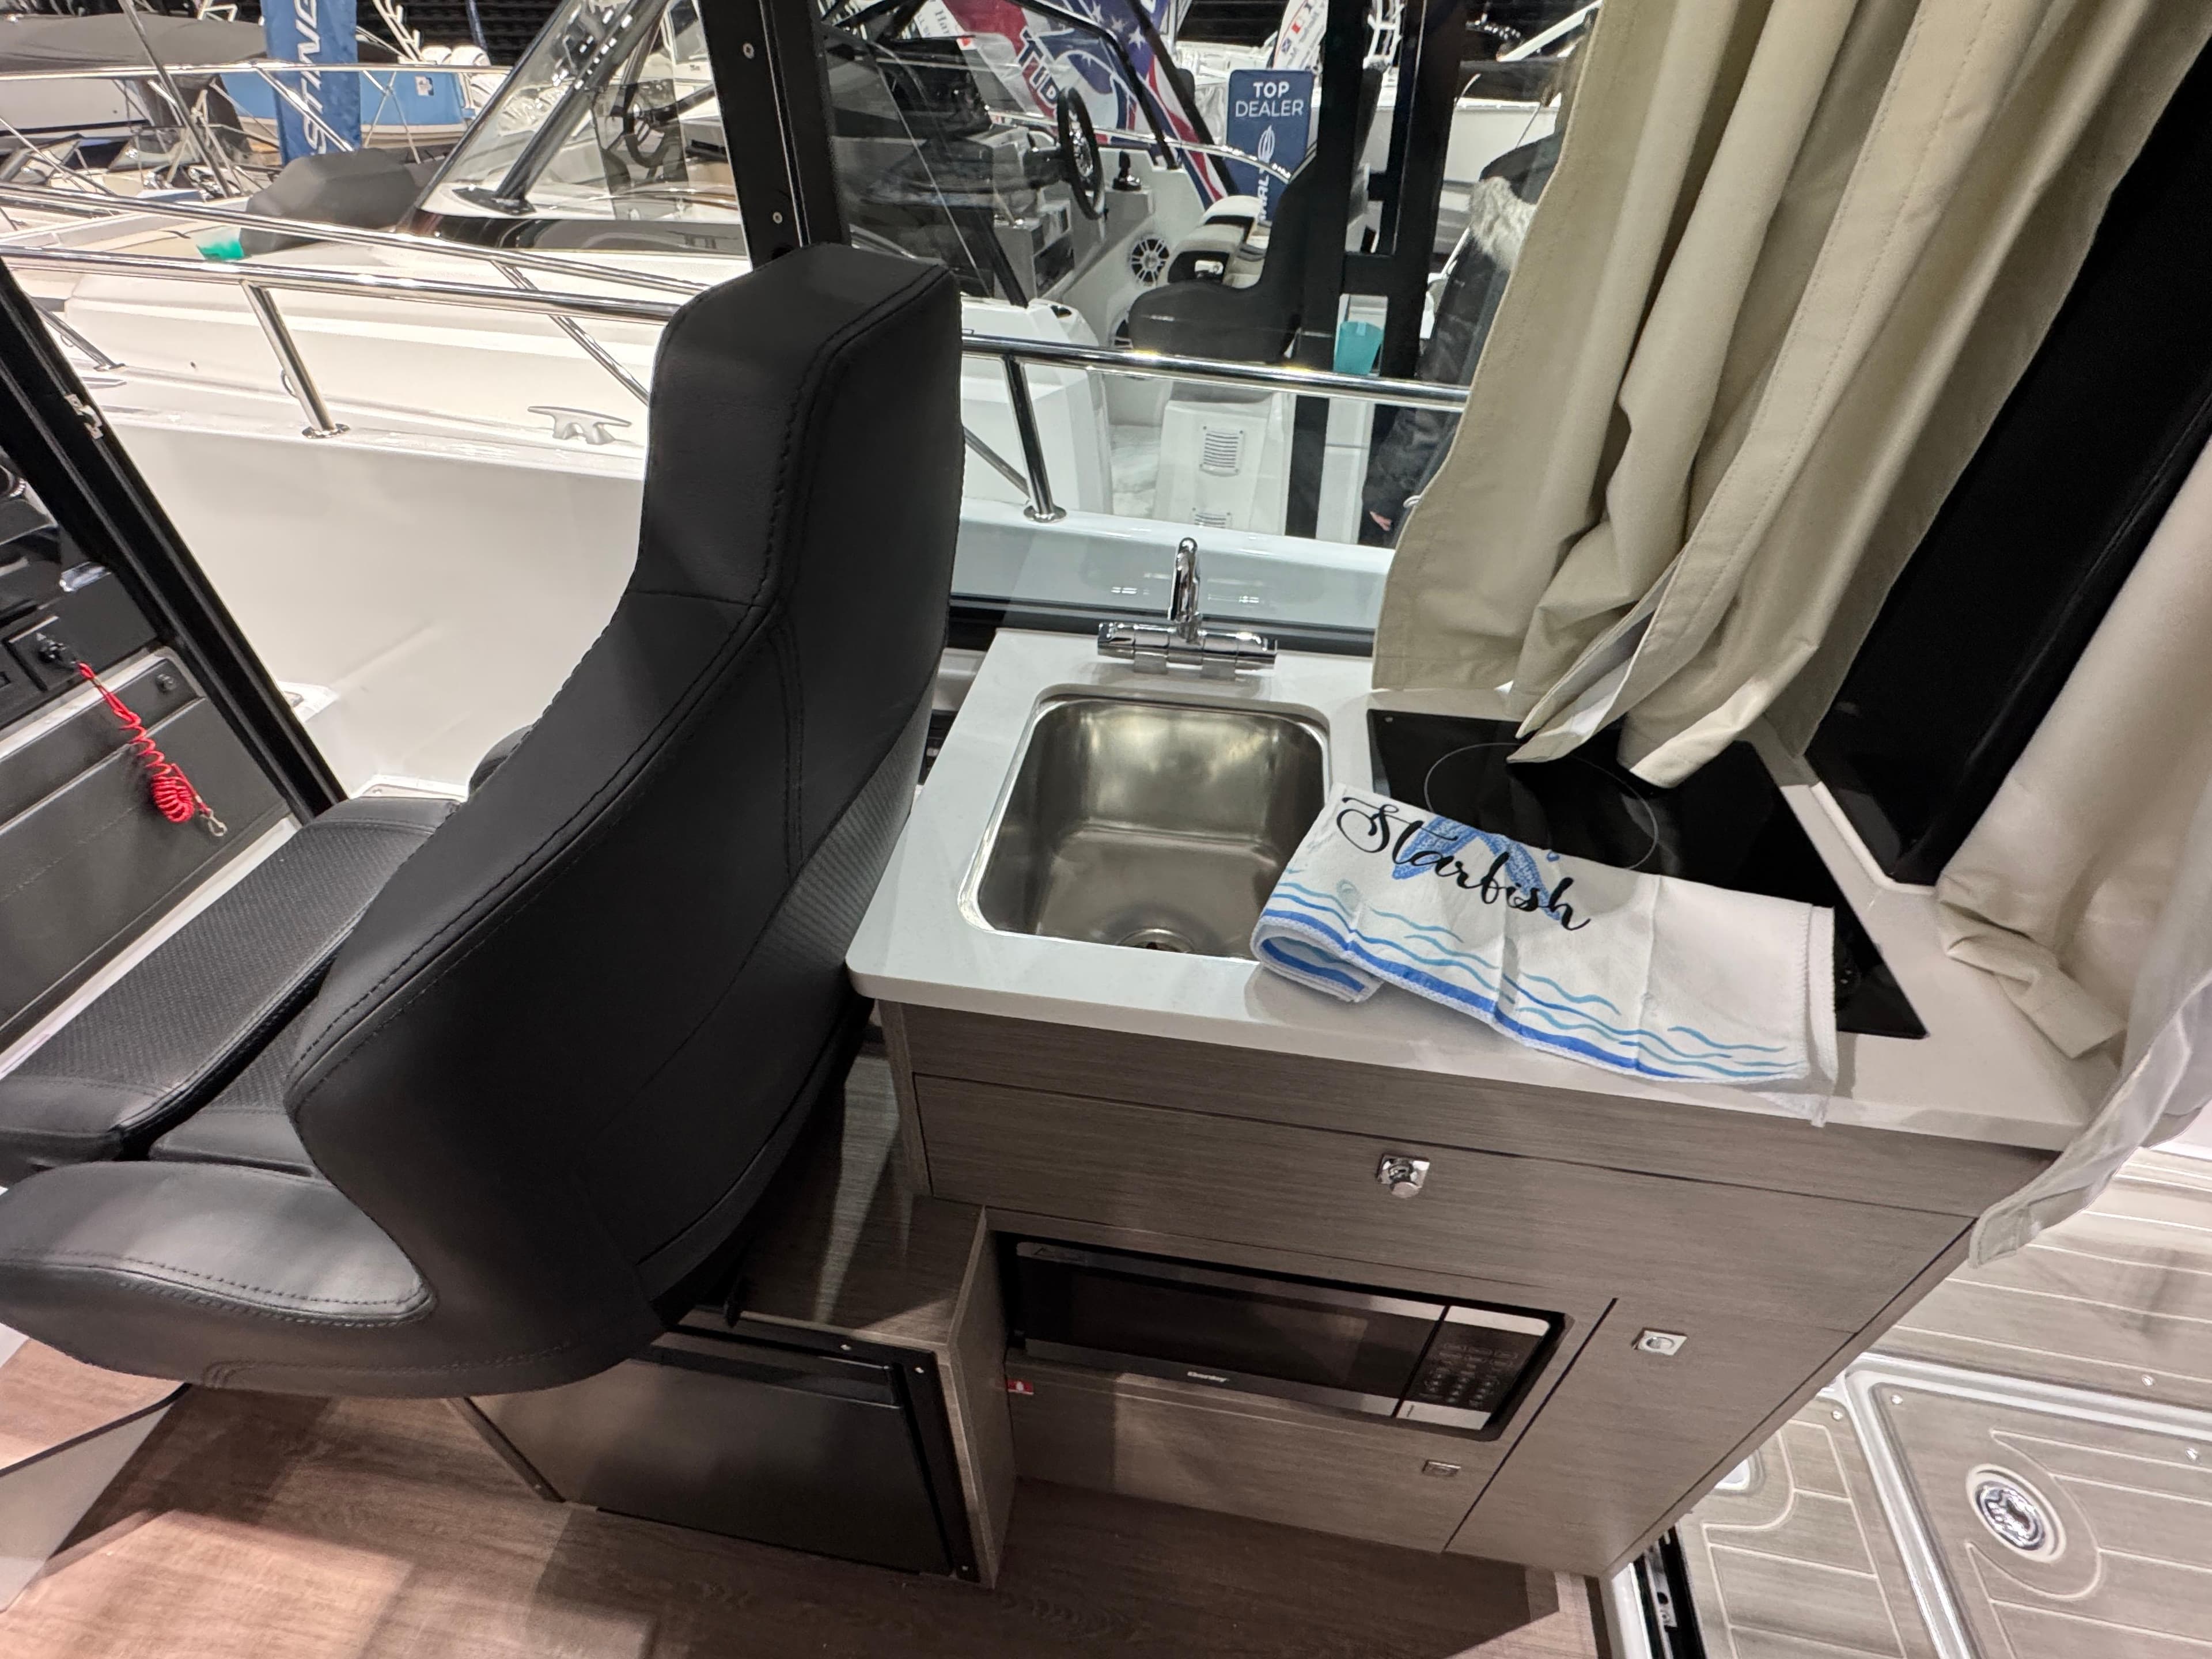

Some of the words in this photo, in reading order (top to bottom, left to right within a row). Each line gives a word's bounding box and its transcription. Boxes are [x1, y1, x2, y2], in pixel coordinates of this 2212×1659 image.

[1017, 27, 1061, 108] TID
[1253, 81, 1290, 99] TOP
[1235, 99, 1304, 118] DEALER
[1336, 797, 1591, 931] Starfish
